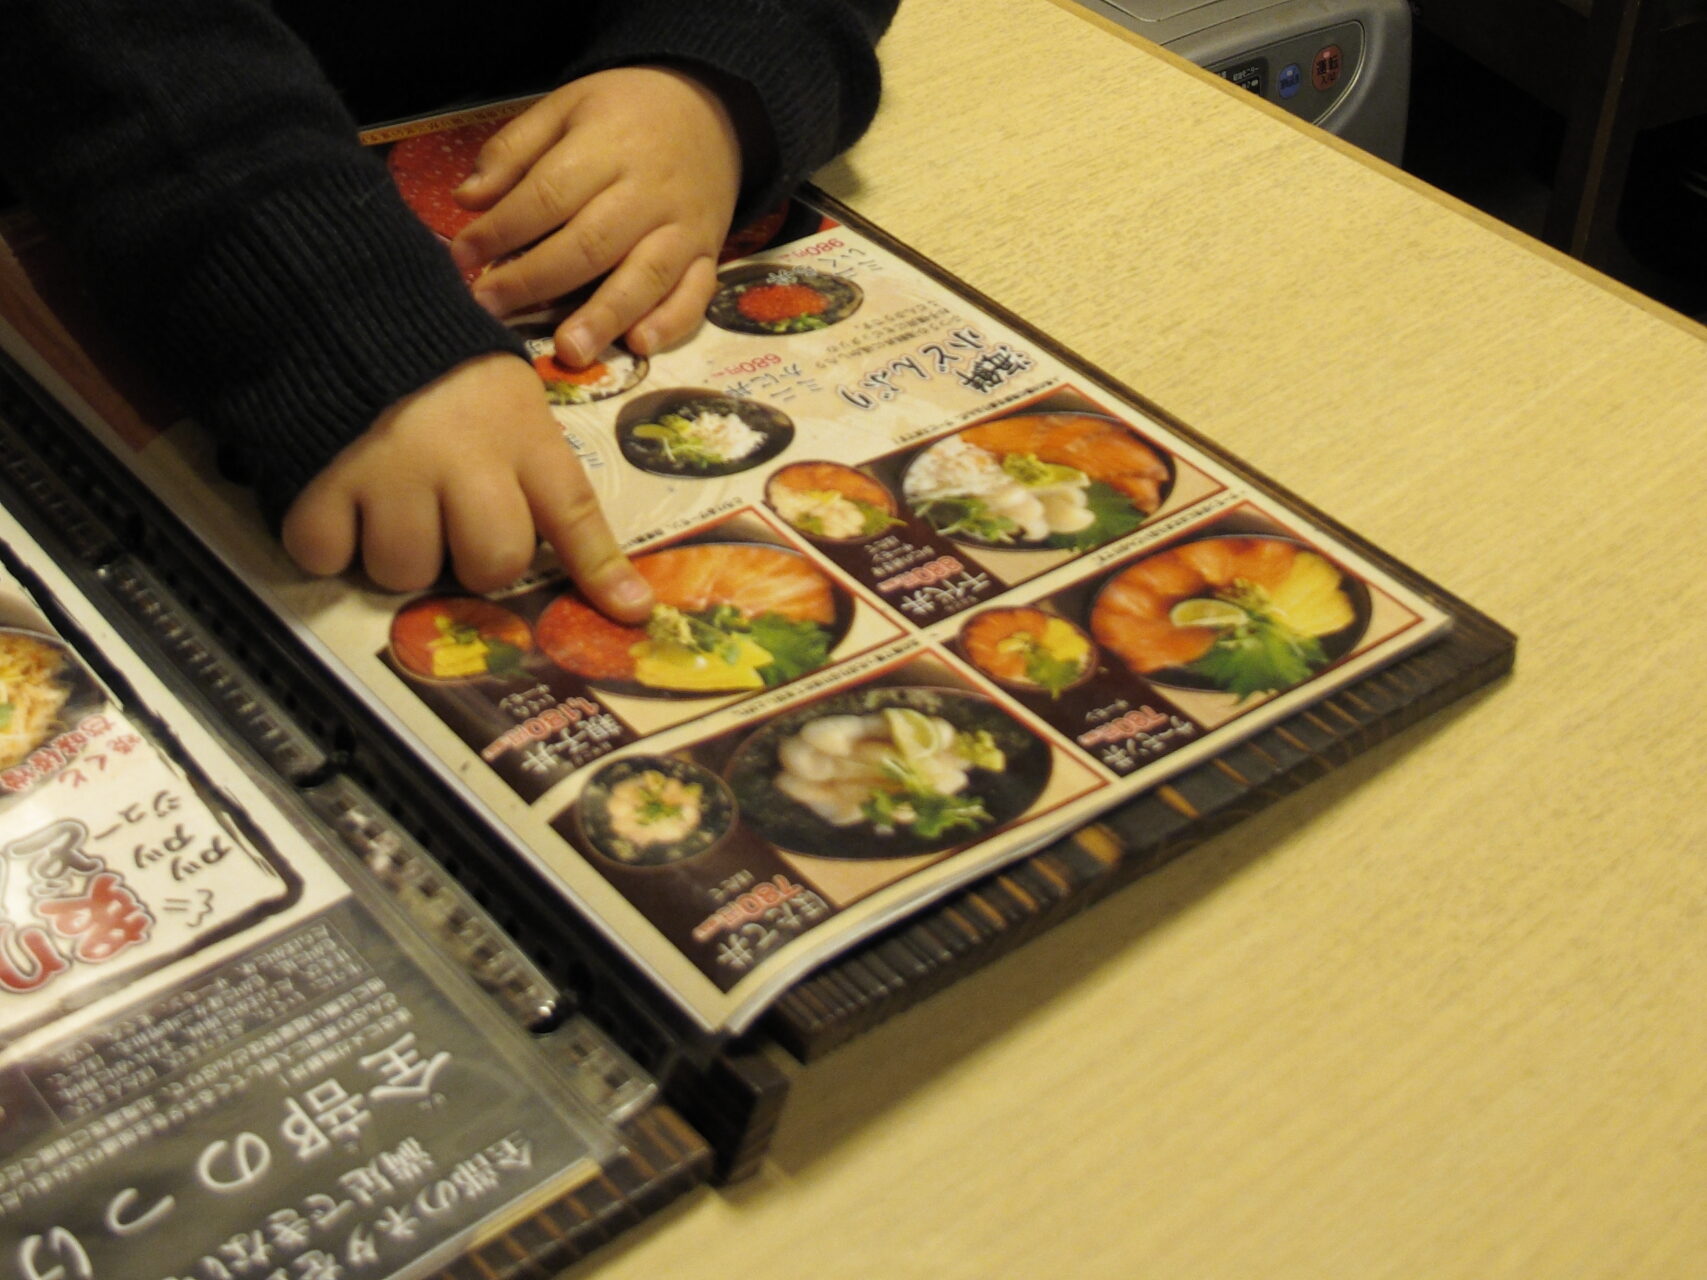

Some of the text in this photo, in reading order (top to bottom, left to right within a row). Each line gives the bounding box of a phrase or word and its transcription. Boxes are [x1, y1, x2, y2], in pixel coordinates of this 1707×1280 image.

[956, 346, 1033, 393] 海鮮
[520, 713, 622, 773] 親子丼
[1102, 715, 1196, 771] サーモン丼
[716, 890, 830, 969] ほたて丼
[263, 1130, 534, 1280] 全部のネタを
